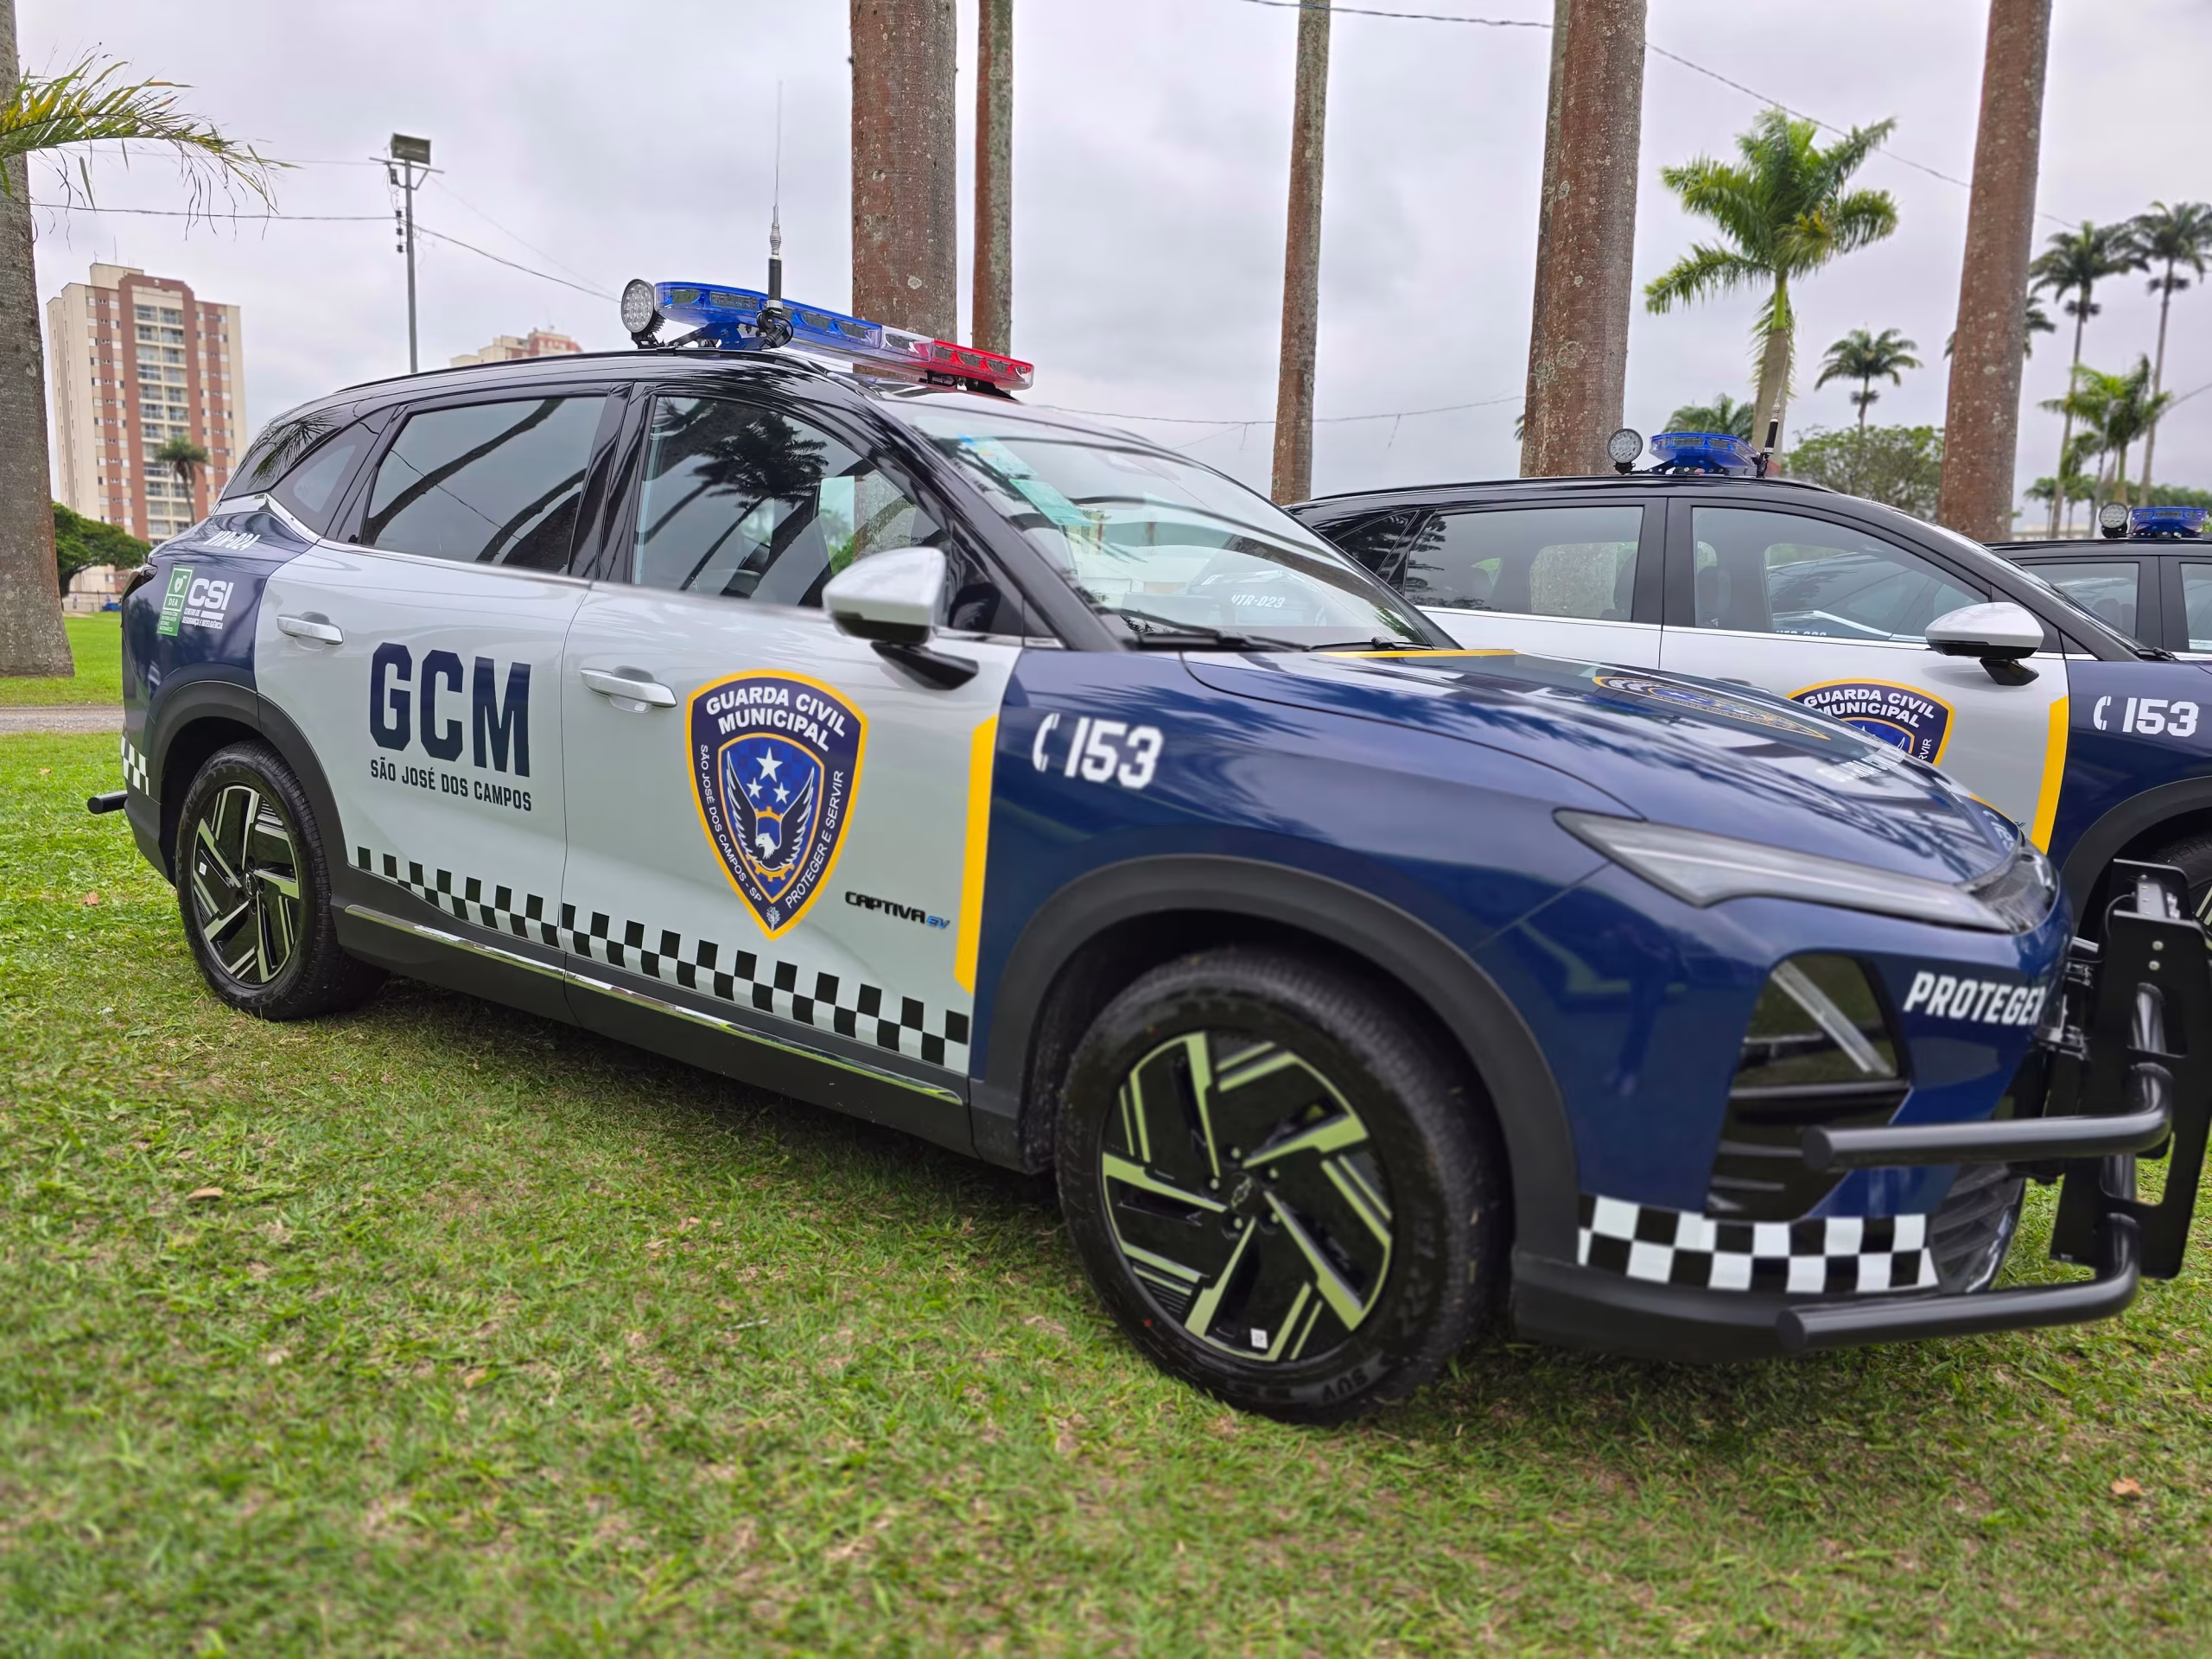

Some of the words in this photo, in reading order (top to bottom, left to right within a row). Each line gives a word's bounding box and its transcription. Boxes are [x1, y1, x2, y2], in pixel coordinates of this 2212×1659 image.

[168, 597, 178, 607] DEA
[188, 577, 234, 611] CSI
[1230, 594, 1286, 608] VTR-023
[370, 642, 531, 778] GCM
[706, 686, 789, 715] GUARDA
[796, 693, 846, 738] CIVIL
[1803, 689, 1882, 709] GUARDA
[1888, 691, 1935, 719] CIVIL
[2122, 697, 2200, 737] 153
[718, 708, 830, 753] MUNICIPAL
[700, 744, 710, 770] SÃO
[1064, 716, 1164, 790] 153
[1918, 738, 1933, 760] RVIR
[371, 756, 397, 782] SÃO
[402, 767, 435, 791] JOSÉ
[442, 773, 468, 798] DOS
[474, 780, 532, 812] CAMPOS
[702, 772, 715, 804] JOSÉ
[825, 770, 844, 830] SERVIR
[709, 806, 722, 832] DOS
[821, 830, 832, 843] E
[719, 834, 747, 882] CAMPOS
[785, 842, 828, 909] PROTEGER
[749, 887, 762, 902] SP
[845, 891, 925, 924] CAPTIVA
[925, 915, 950, 930] EV
